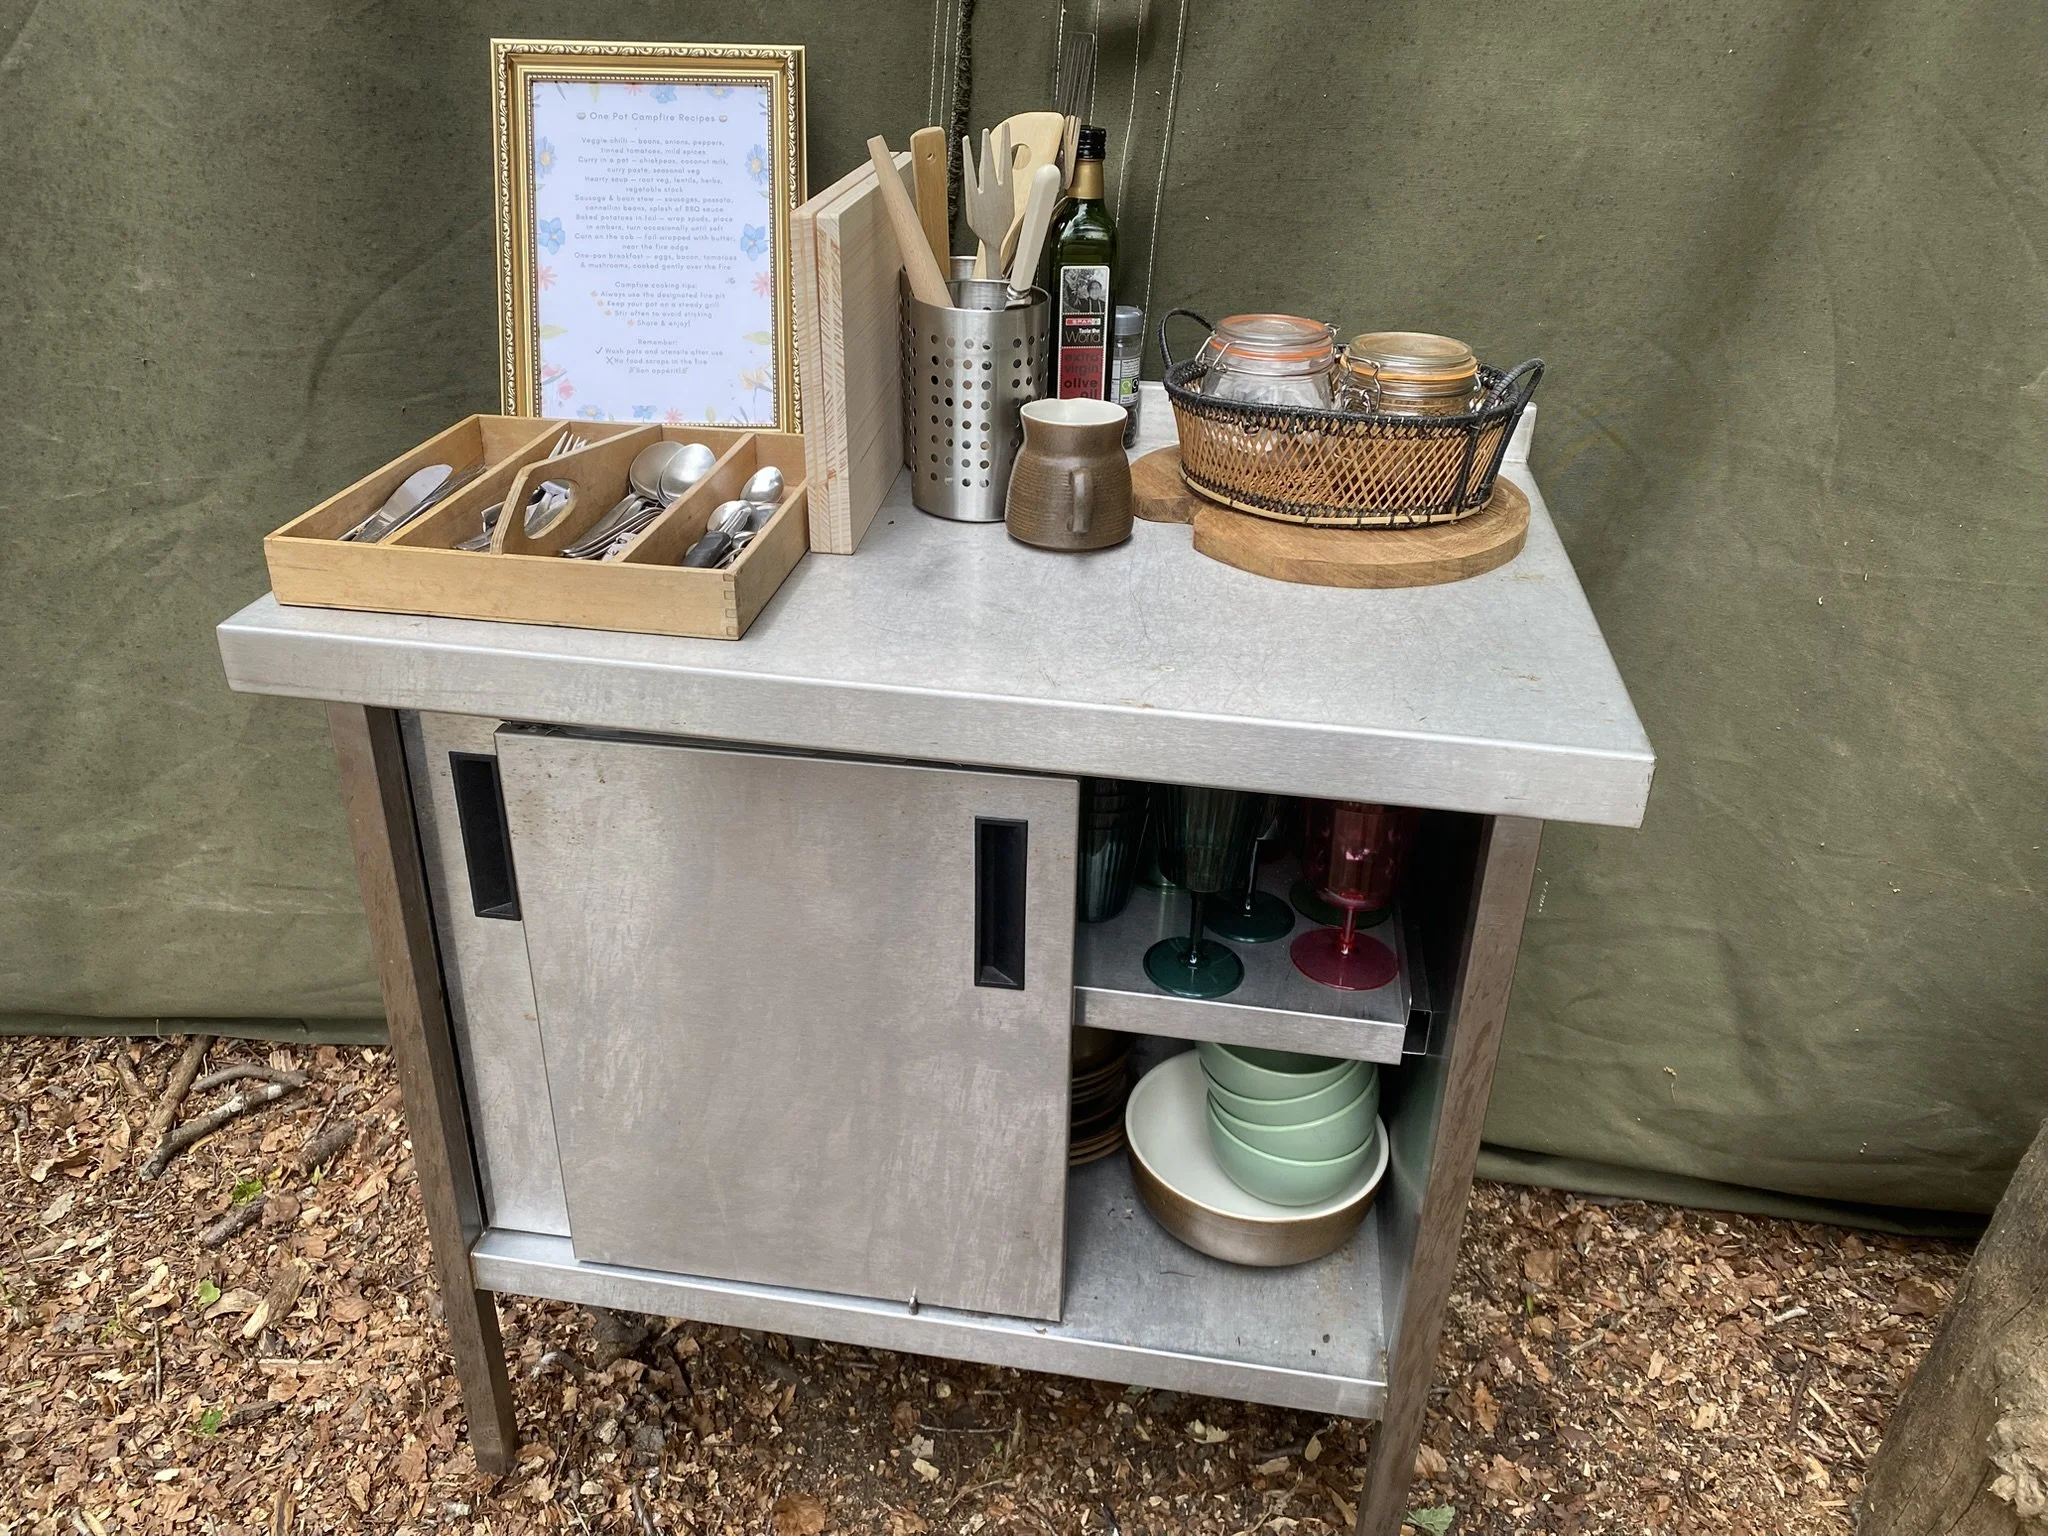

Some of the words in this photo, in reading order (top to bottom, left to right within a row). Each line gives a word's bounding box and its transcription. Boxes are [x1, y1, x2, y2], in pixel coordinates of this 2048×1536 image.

[590, 112, 609, 121] One
[613, 113, 627, 121] Pot
[632, 113, 675, 123] Campfire
[679, 114, 715, 123] Recipes
[581, 137, 608, 146] Veggie
[578, 156, 598, 165] Curry
[608, 167, 625, 175] curry
[585, 176, 608, 184] Hearty
[575, 195, 606, 203] Sausage
[650, 205, 672, 214] splash
[601, 215, 633, 223] potatoes
[713, 216, 733, 224] place
[644, 225, 689, 233] occasionally
[659, 234, 691, 242] wrapped
[574, 253, 606, 261] One-pan
[662, 263, 684, 271] gently
[615, 281, 649, 290] Campfire
[651, 282, 679, 290] cooking
[601, 291, 625, 299] Always
[657, 292, 698, 300] designated
[715, 292, 726, 300] pit
[607, 301, 625, 309] Keep
[646, 301, 658, 309] pot
[679, 301, 703, 310] steady
[668, 320, 691, 328] enjoy!
[1065, 330, 1100, 343] World
[1064, 353, 1098, 362] extra
[1064, 365, 1098, 375] virgin
[1064, 378, 1097, 388] olive
[1080, 389, 1096, 399] oil
